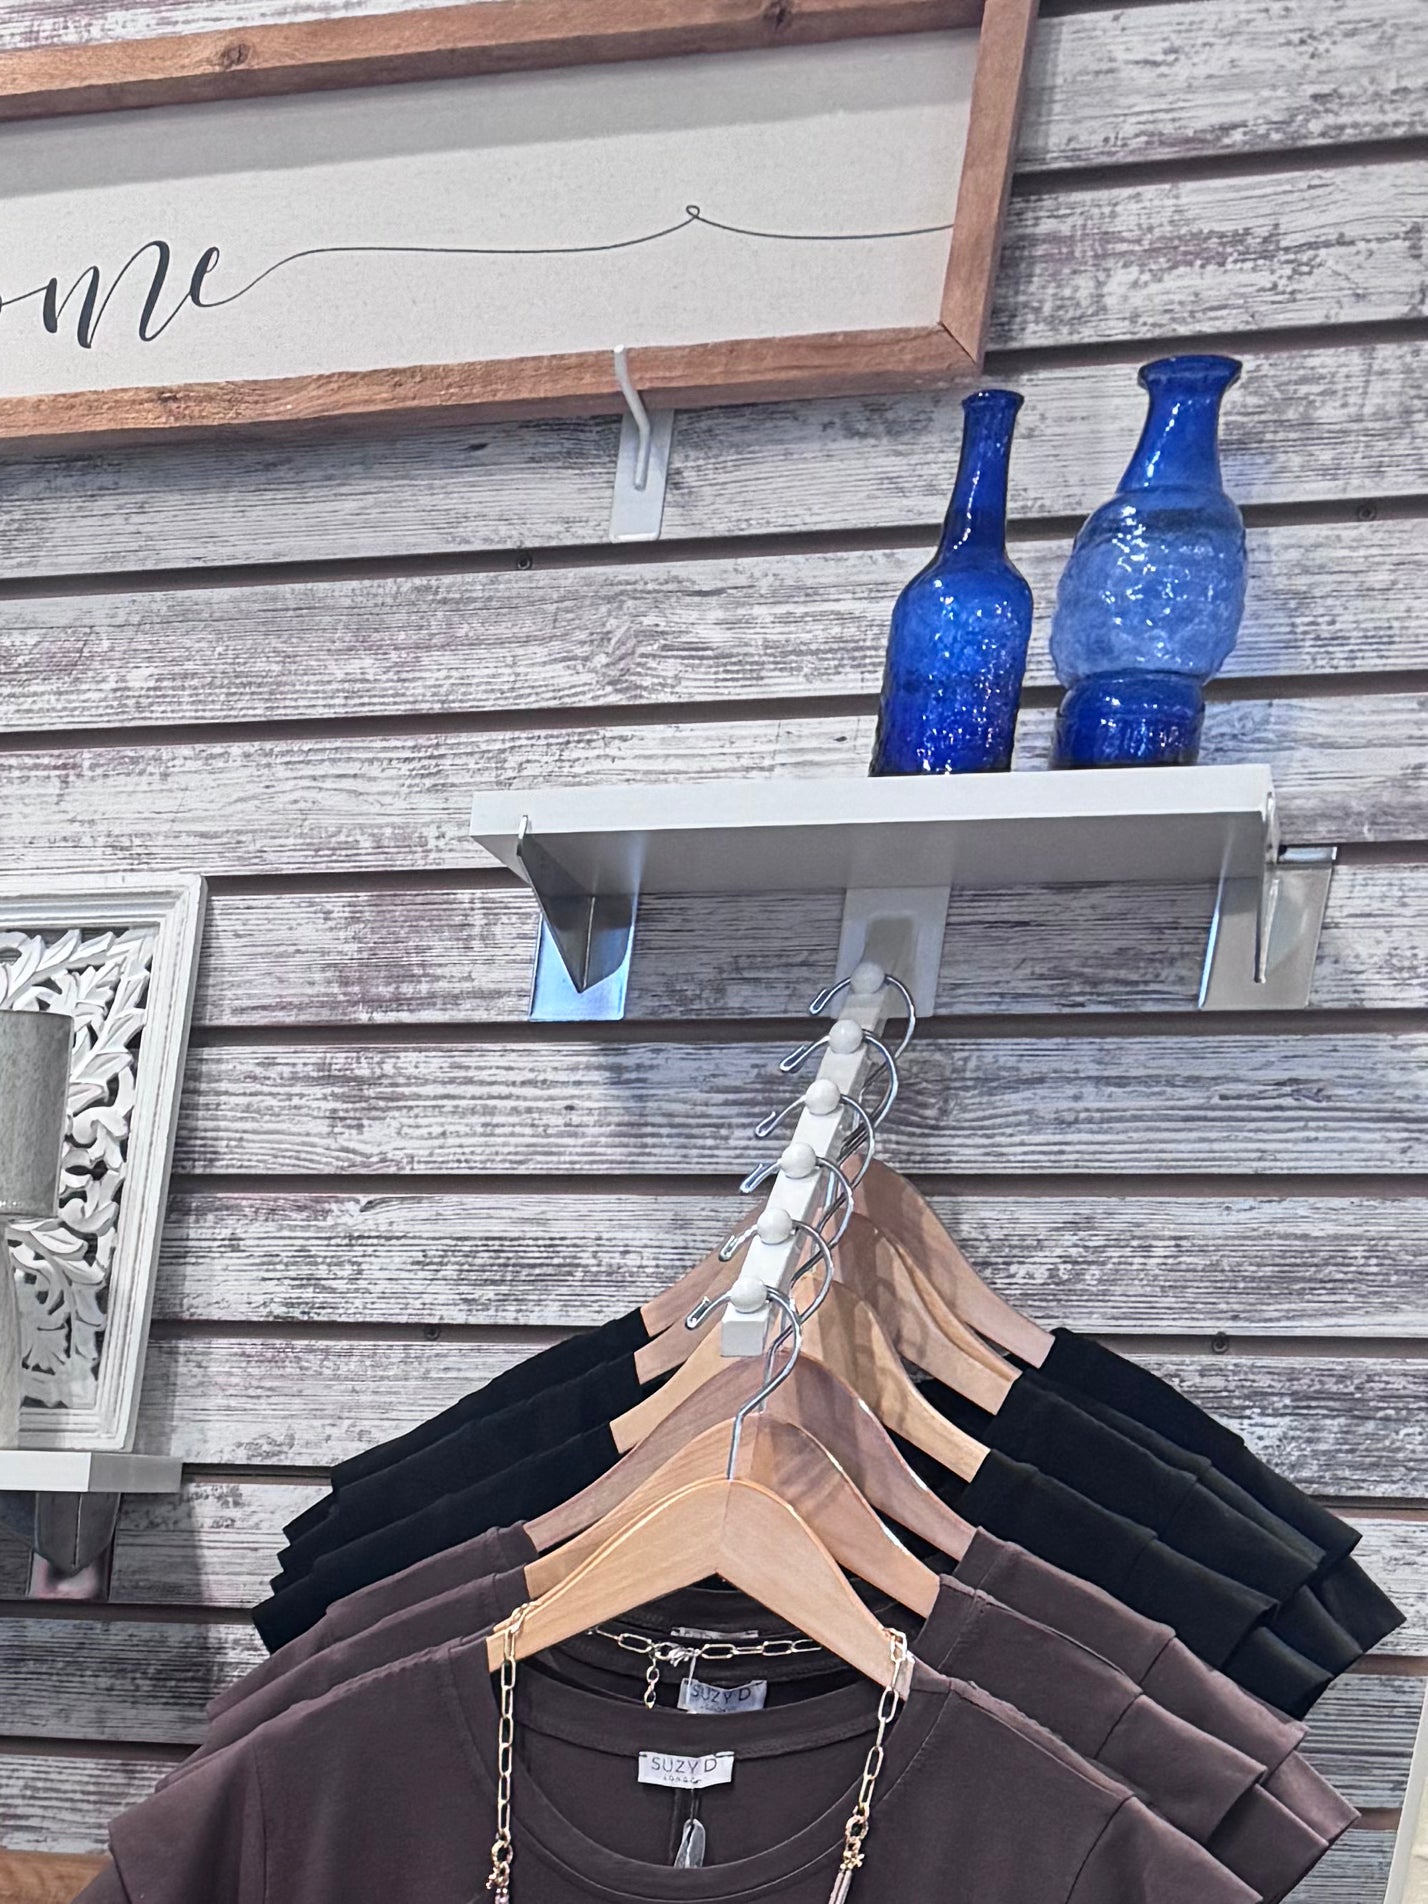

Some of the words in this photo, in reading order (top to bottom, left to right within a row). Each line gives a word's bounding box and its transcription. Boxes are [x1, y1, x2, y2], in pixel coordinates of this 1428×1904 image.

[691, 1684, 733, 1704] SUZY
[738, 1687, 752, 1701] D
[651, 1756, 699, 1774] SUZY
[704, 1758, 717, 1773] D
